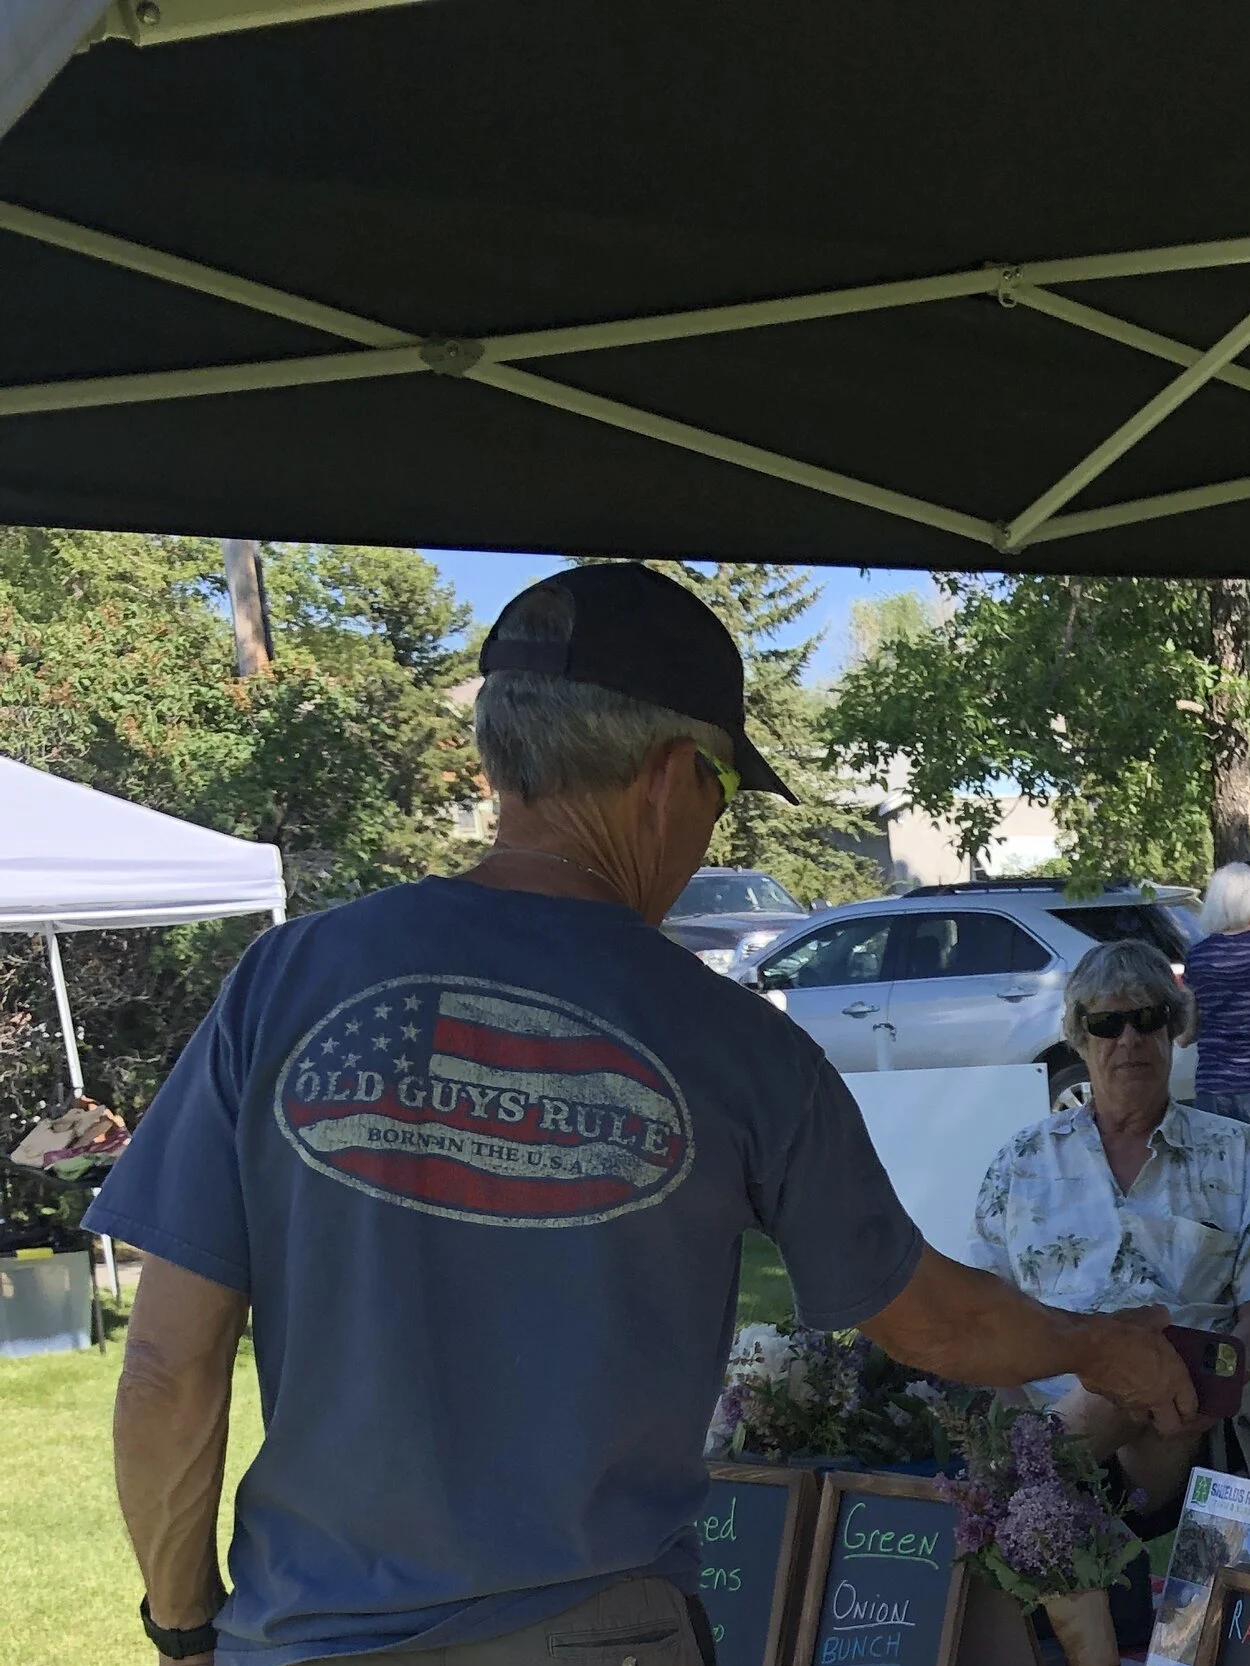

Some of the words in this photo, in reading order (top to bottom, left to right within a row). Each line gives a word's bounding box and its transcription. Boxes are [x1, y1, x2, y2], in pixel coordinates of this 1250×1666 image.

[295, 1070, 385, 1102] OLD
[399, 1075, 527, 1123] GUYS
[539, 1098, 680, 1157] RULE
[367, 1127, 429, 1149] BORN
[437, 1135, 465, 1153] IN
[471, 1141, 520, 1162] THE
[1210, 1482, 1245, 1502] SHIELDS
[821, 1632, 902, 1665] BUNCH
